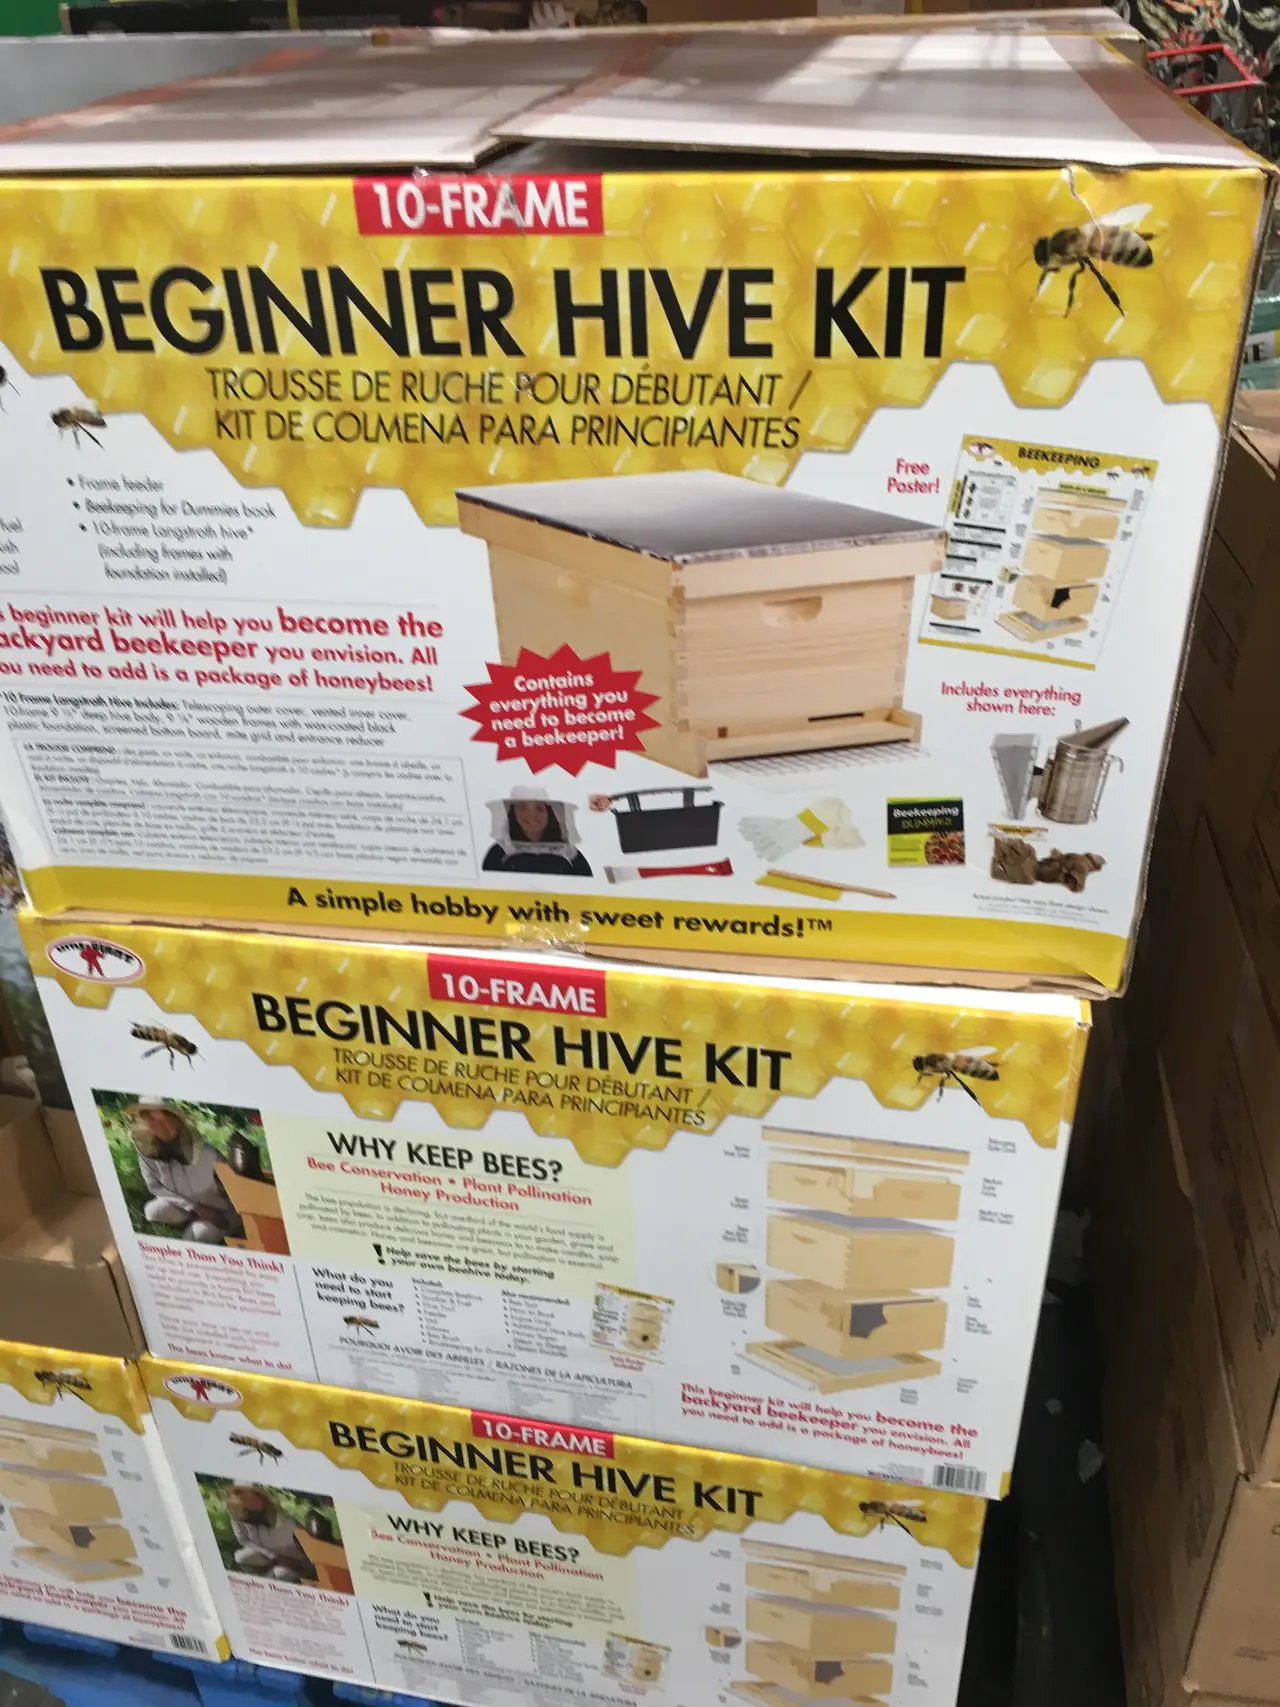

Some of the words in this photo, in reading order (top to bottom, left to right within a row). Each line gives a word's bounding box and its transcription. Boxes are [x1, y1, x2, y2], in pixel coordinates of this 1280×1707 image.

[372, 181, 589, 230] 10-FRAME
[39, 266, 525, 357] BEGINNER
[552, 267, 773, 359] HIVE
[814, 266, 966, 359] KIT
[205, 367, 343, 403] TROUSSE
[352, 369, 391, 402] DE
[401, 370, 503, 403] RUCHE
[516, 372, 600, 405] POUR
[611, 363, 782, 407] DÉBUTANT
[214, 411, 256, 442] KIT
[267, 412, 304, 442] DE
[313, 412, 469, 445] COLMENA
[478, 414, 560, 446] PARA
[570, 414, 801, 448] PRINCIPIANTES
[896, 458, 930, 476] Free
[1018, 447, 1100, 469] BEEKEEPING
[887, 477, 940, 495] Poster!
[8, 605, 99, 629] beginner
[104, 606, 133, 627] kit
[139, 609, 176, 629] will
[181, 610, 228, 634] help
[232, 615, 273, 636] you
[277, 606, 389, 636] become
[397, 612, 444, 638] the
[0, 626, 105, 656] ackyard
[111, 630, 260, 663] beekeeper
[264, 643, 303, 663] you
[311, 644, 402, 665] envision.
[410, 646, 439, 666] All
[0, 661, 23, 676] ou
[28, 659, 77, 678] need
[81, 661, 102, 679] to
[108, 662, 147, 681] add
[153, 664, 169, 683] is
[175, 668, 189, 683] a
[195, 667, 283, 692] package
[288, 669, 308, 689] of
[314, 670, 434, 695] honeybees!
[513, 670, 594, 693] Contains
[940, 681, 1000, 698] Includes
[1003, 683, 1082, 706] everything
[489, 692, 588, 715] everything
[592, 690, 628, 709] you
[491, 713, 536, 731] need
[541, 713, 559, 728] to
[564, 708, 636, 726] become
[966, 700, 1015, 714] shown
[504, 736, 517, 748] a
[521, 725, 625, 748] beekeeper!
[892, 805, 960, 820] Beekeeping
[286, 886, 309, 908] A
[315, 888, 403, 918] simple
[410, 893, 499, 925] hobby
[506, 899, 571, 925] with
[580, 906, 665, 931] sweet
[442, 972, 597, 1013] 10-FRAME
[252, 992, 533, 1063] BEGINNER
[555, 1026, 682, 1079] HIVE
[706, 1042, 793, 1091] KIT
[333, 1047, 419, 1072] TROUSSE
[422, 1058, 449, 1075] DE
[454, 1061, 520, 1084] RUCHE
[525, 1069, 581, 1092] POUR
[587, 1070, 694, 1106] DÉBUTANT
[335, 1067, 365, 1086] KIT
[368, 1071, 394, 1089] DE
[397, 1075, 497, 1103] COLMENA
[500, 1087, 555, 1109] PARA
[559, 1093, 706, 1127] PRINCIPIANTES
[326, 1131, 397, 1161] WHY
[406, 1141, 473, 1170] KEEP
[483, 1152, 564, 1183] BEES?
[306, 1156, 336, 1173] Bee
[339, 1161, 442, 1186] Conservation
[463, 1177, 502, 1194] Plant
[507, 1182, 593, 1207] Pollination
[380, 1182, 429, 1202] Honey
[435, 1188, 520, 1211] Production
[311, 1266, 347, 1281] What
[350, 1272, 366, 1285] do
[370, 1277, 394, 1289] you
[315, 1281, 345, 1293] need
[350, 1285, 361, 1296] to
[365, 1288, 392, 1300] start
[316, 1290, 367, 1310] keeping
[681, 1382, 705, 1395] This
[708, 1387, 764, 1404] beginner
[768, 1396, 785, 1408] kit
[788, 1399, 812, 1412] will
[815, 1403, 843, 1418] help
[847, 1411, 872, 1422] you
[876, 1411, 944, 1433] become
[950, 1421, 978, 1438] the
[681, 1392, 761, 1416] backyard
[767, 1405, 857, 1431] beekeeper
[862, 1424, 887, 1436] you
[953, 1437, 970, 1449] All
[681, 1406, 705, 1417] you
[708, 1411, 739, 1423] need
[742, 1415, 755, 1425] to
[758, 1417, 783, 1430] add
[787, 1422, 797, 1432] is
[800, 1426, 809, 1435] a
[813, 1427, 868, 1446] package
[871, 1437, 885, 1448] of
[482, 1419, 606, 1457] 10-FRAME
[328, 1420, 558, 1484] BEGINNER
[572, 1461, 676, 1504] HIVE
[693, 1480, 764, 1518] KIT
[393, 1461, 461, 1483] TROUSSE
[466, 1474, 487, 1487] DE
[493, 1478, 544, 1499] RUCHE
[549, 1487, 594, 1507] POUR
[394, 1474, 415, 1487] KIT
[420, 1477, 442, 1491] DE
[446, 1482, 525, 1508] COLMENA
[529, 1497, 572, 1516] PARA
[576, 1506, 696, 1535] PRINCIPIANTES
[386, 1514, 444, 1539] WHY
[452, 1527, 507, 1549] KEEP
[514, 1537, 580, 1565] BEES?
[397, 1535, 481, 1558] Conservation
[497, 1552, 530, 1568] Plant
[535, 1560, 604, 1581] Pollination
[430, 1550, 470, 1568] Honey
[476, 1560, 545, 1580] Production
